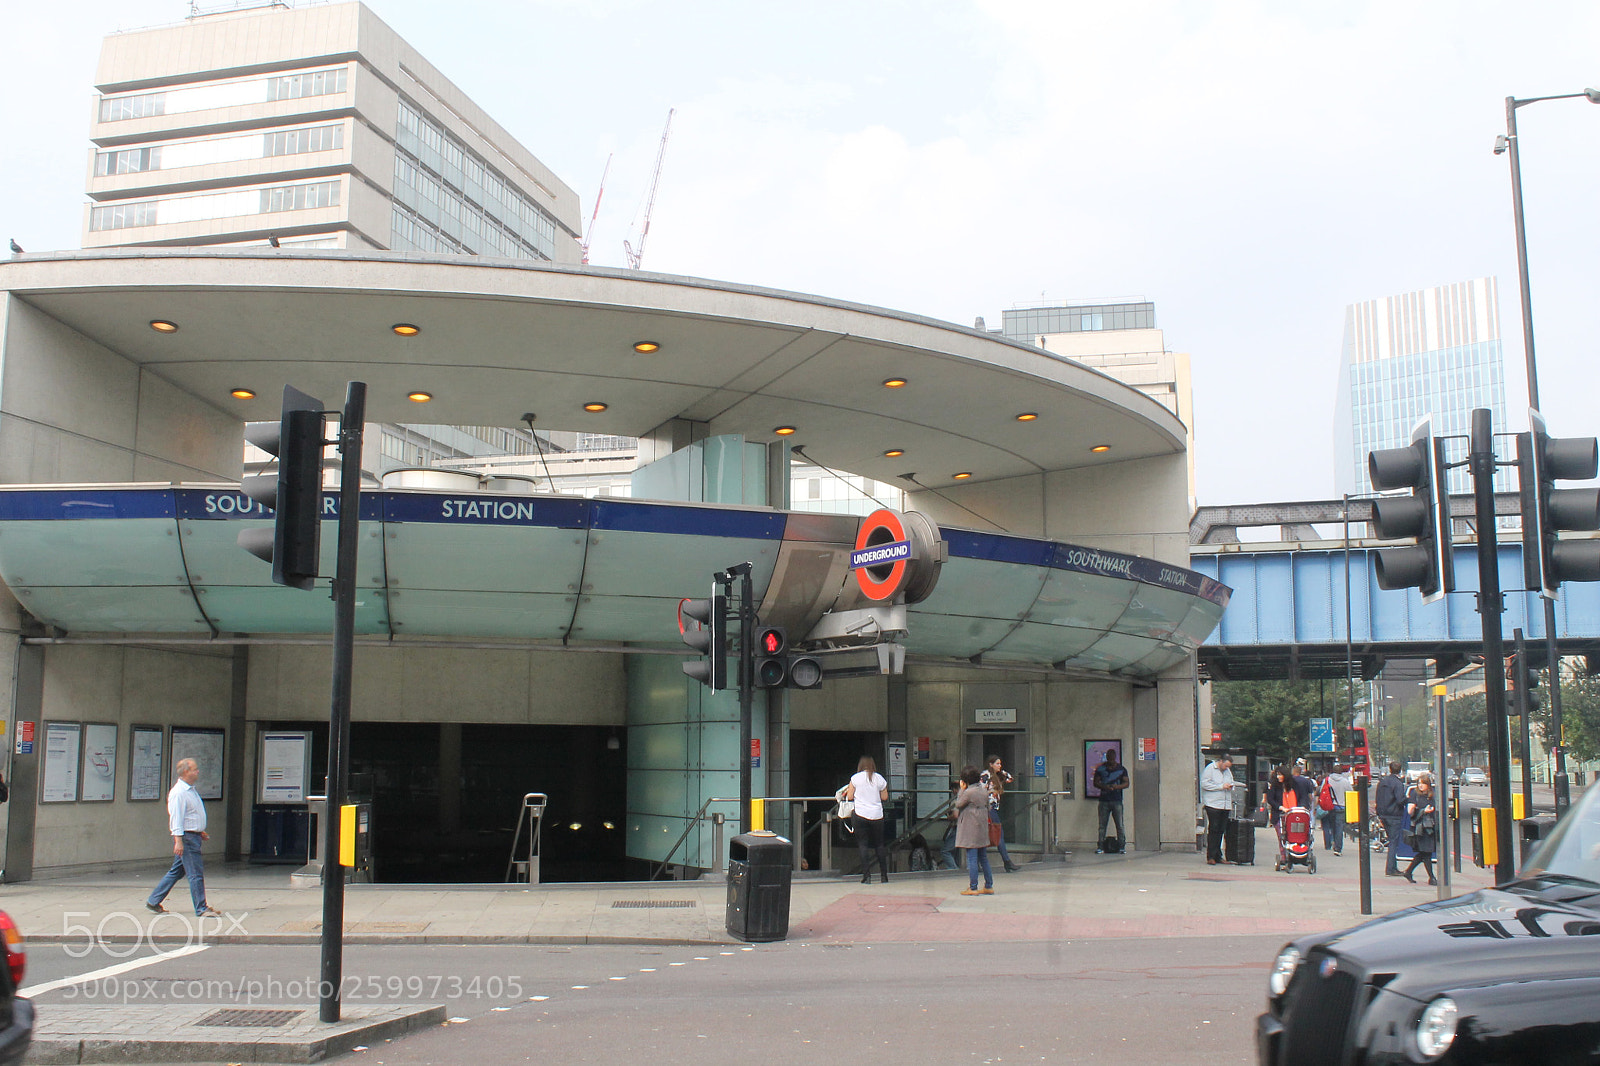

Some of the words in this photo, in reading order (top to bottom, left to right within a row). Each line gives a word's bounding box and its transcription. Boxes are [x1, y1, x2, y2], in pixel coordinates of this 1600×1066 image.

[441, 499, 534, 521] STATION
[853, 544, 908, 565] UNDERGROUND
[1066, 550, 1134, 575] SOUTHWARK
[1158, 567, 1188, 587] STATION
